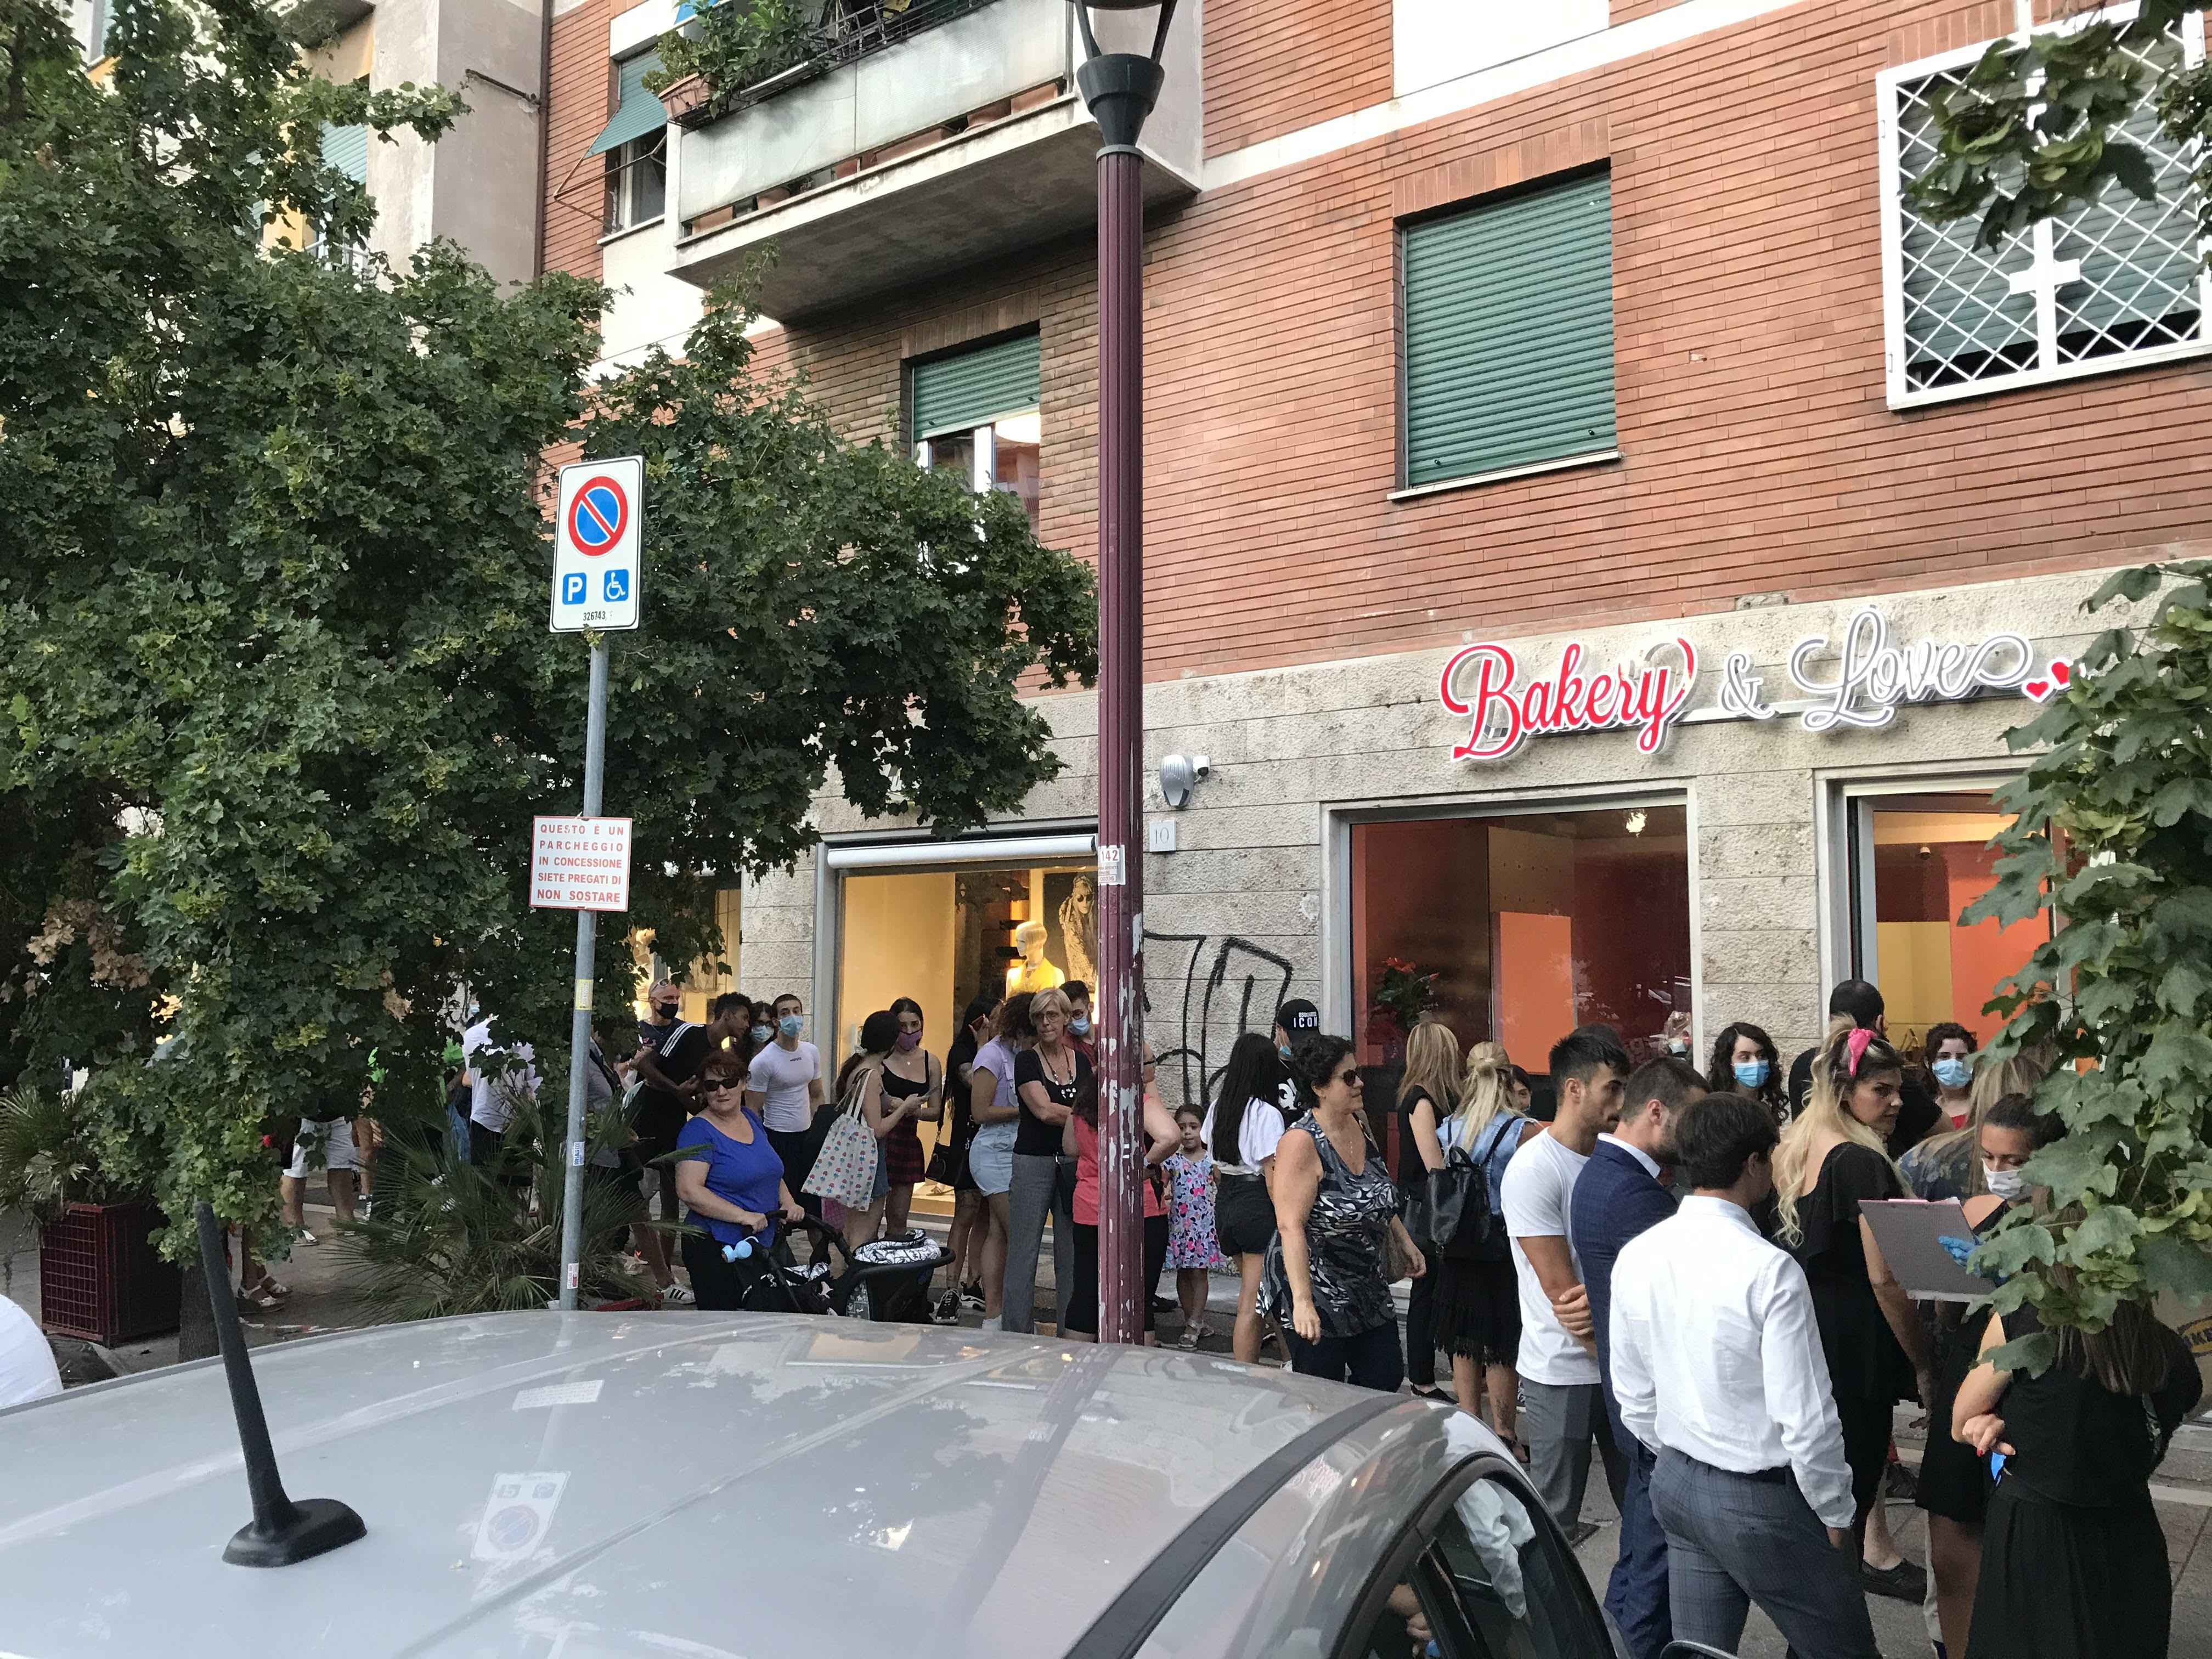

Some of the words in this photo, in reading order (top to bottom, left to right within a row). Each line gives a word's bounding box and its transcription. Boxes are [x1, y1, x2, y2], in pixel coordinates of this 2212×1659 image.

[567, 576, 583, 602] P
[583, 611, 606, 621] 326743
[1440, 635, 1699, 761] Bakery
[1717, 648, 1775, 720] &
[1790, 604, 2034, 732] Love
[540, 824, 585, 834] QUESTO
[594, 823, 600, 834] È
[608, 826, 624, 835] UN
[1155, 827, 1169, 844] 10
[539, 840, 623, 851] PARCHEGGIO
[1102, 850, 1119, 861] 142
[539, 856, 549, 865] IN
[554, 857, 622, 868] CONCESSIONE
[538, 872, 565, 882] SIETE
[568, 873, 608, 884] PREGATI
[612, 876, 621, 884] DI
[537, 889, 561, 899] NON
[569, 890, 620, 902] SOSTARE
[1294, 1017, 1318, 1028] ICON
